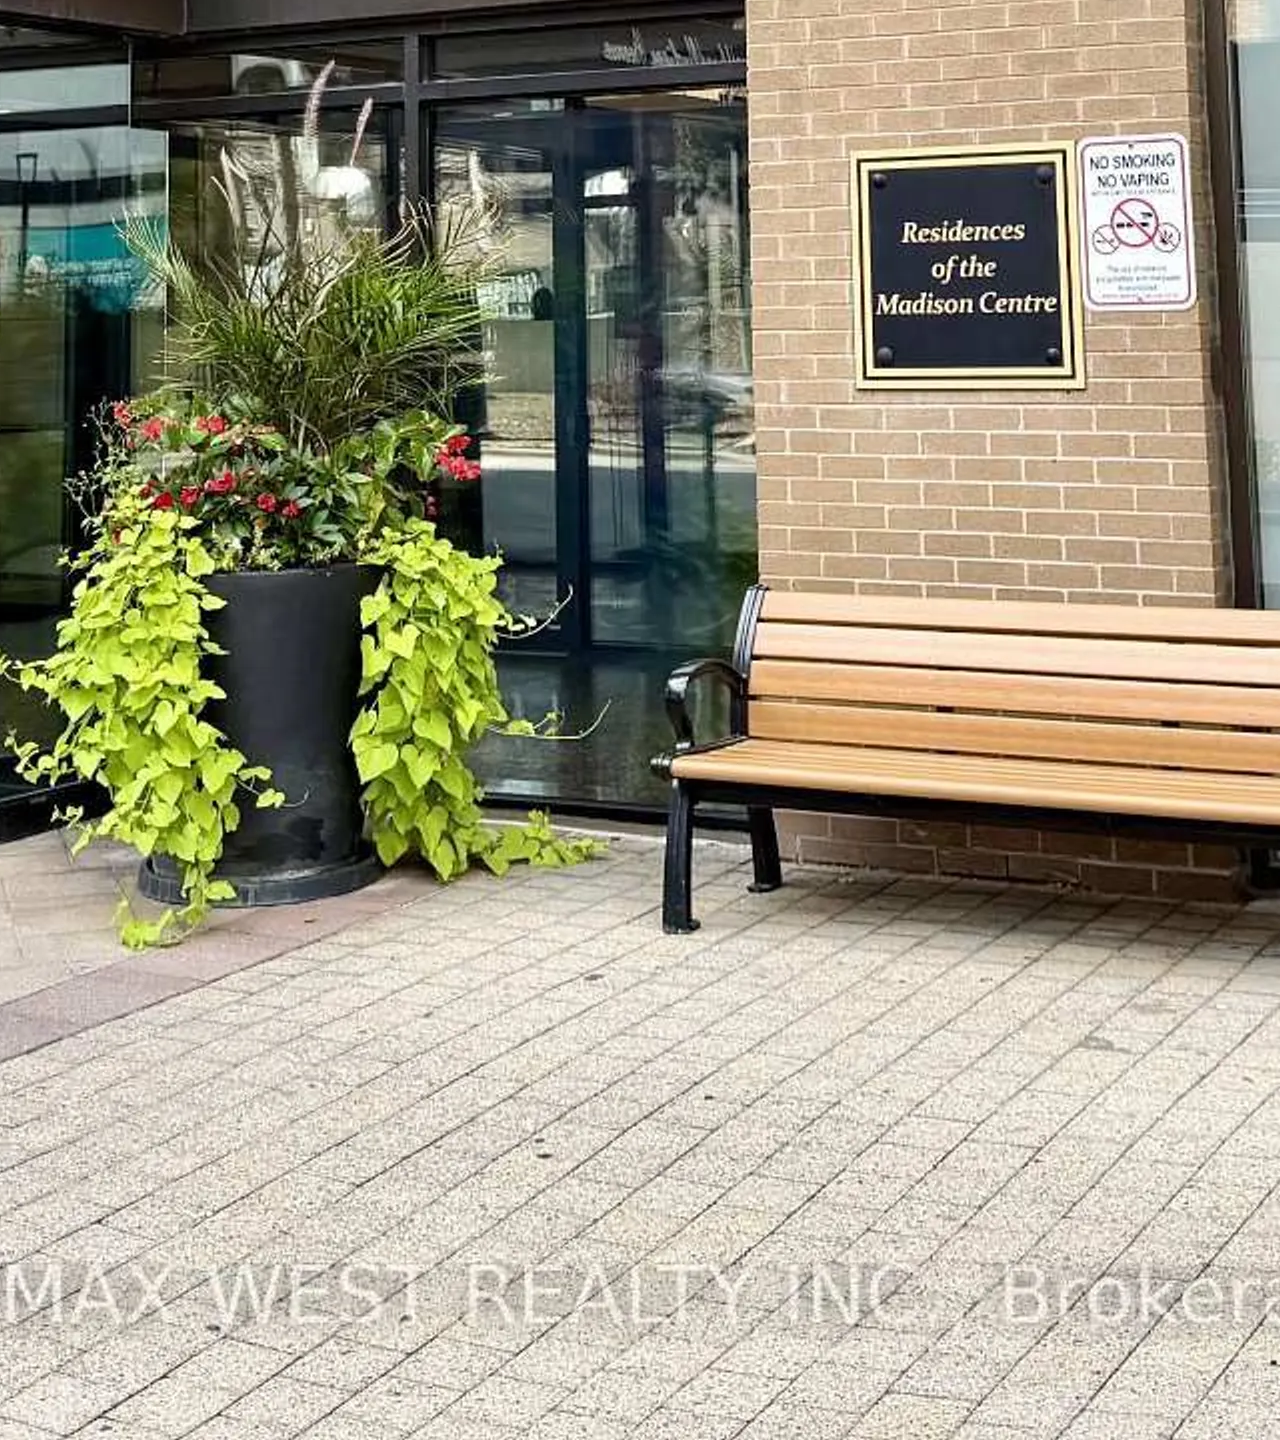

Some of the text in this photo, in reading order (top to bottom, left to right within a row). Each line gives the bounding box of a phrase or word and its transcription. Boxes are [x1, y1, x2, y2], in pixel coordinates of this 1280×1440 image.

[1089, 152, 1175, 171] NO SMOKING
[1097, 172, 1169, 188] NO VAPING
[901, 219, 1025, 244] Residences
[931, 254, 997, 284] of the
[876, 291, 1058, 315] Madison Centre
